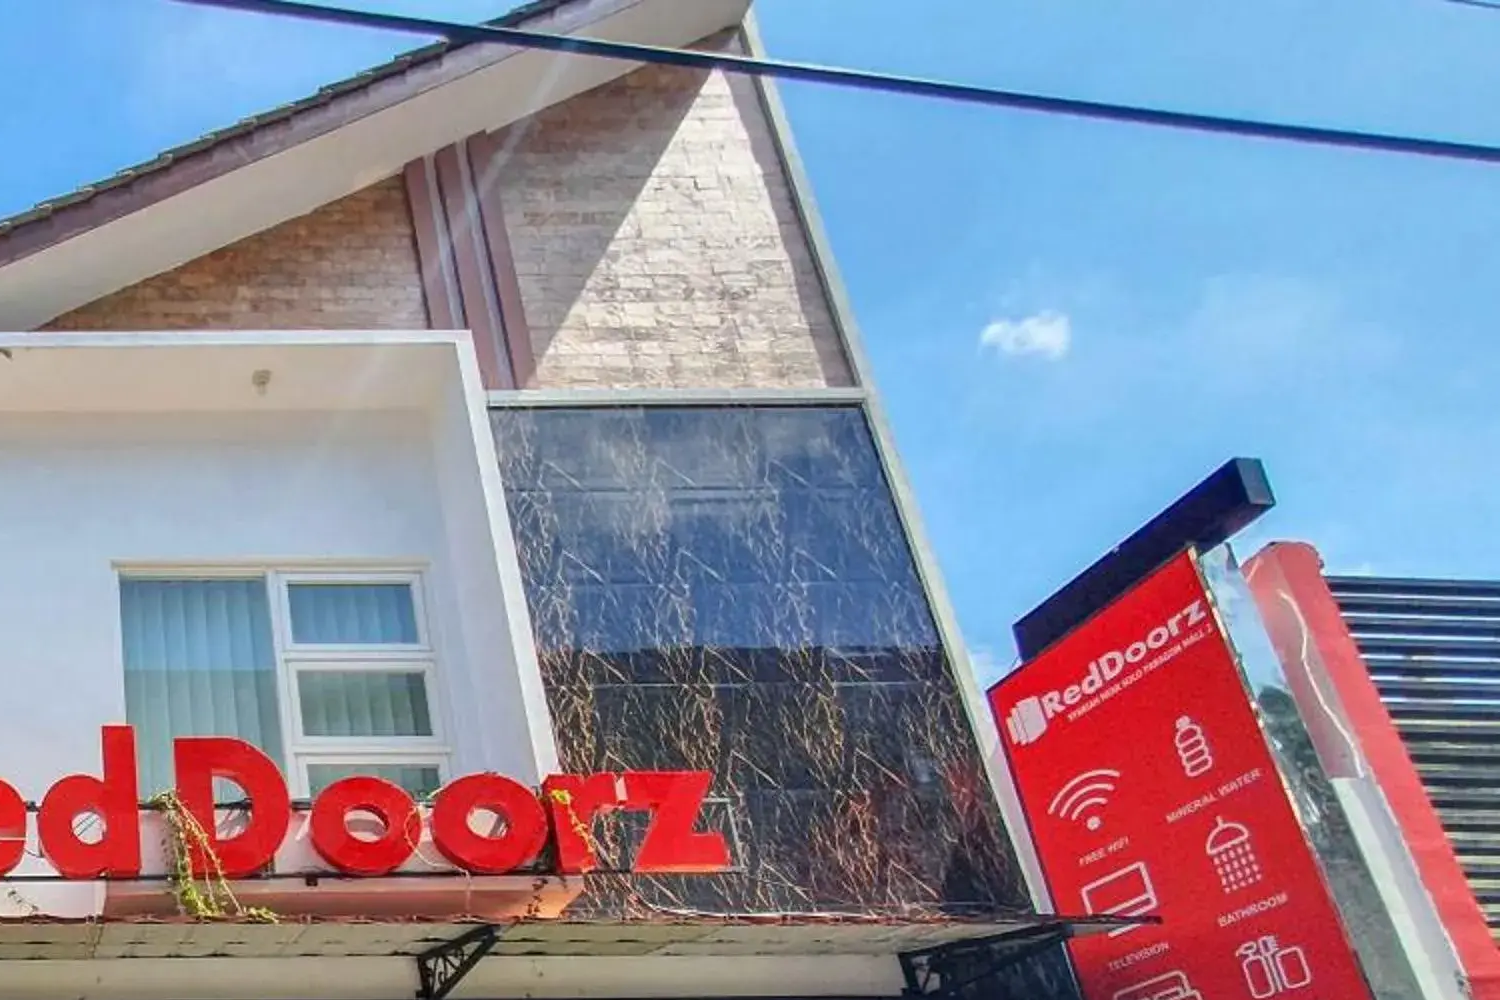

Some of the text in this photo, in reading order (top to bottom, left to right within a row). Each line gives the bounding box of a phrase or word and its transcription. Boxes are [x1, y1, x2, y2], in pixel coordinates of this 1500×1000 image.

[1041, 600, 1207, 719] RedDoorz
[1165, 768, 1263, 824] MINERAL WATER
[1079, 847, 1107, 866] FREE
[1217, 892, 1288, 927] BATHROOM
[1108, 942, 1170, 971] TELEVISION
